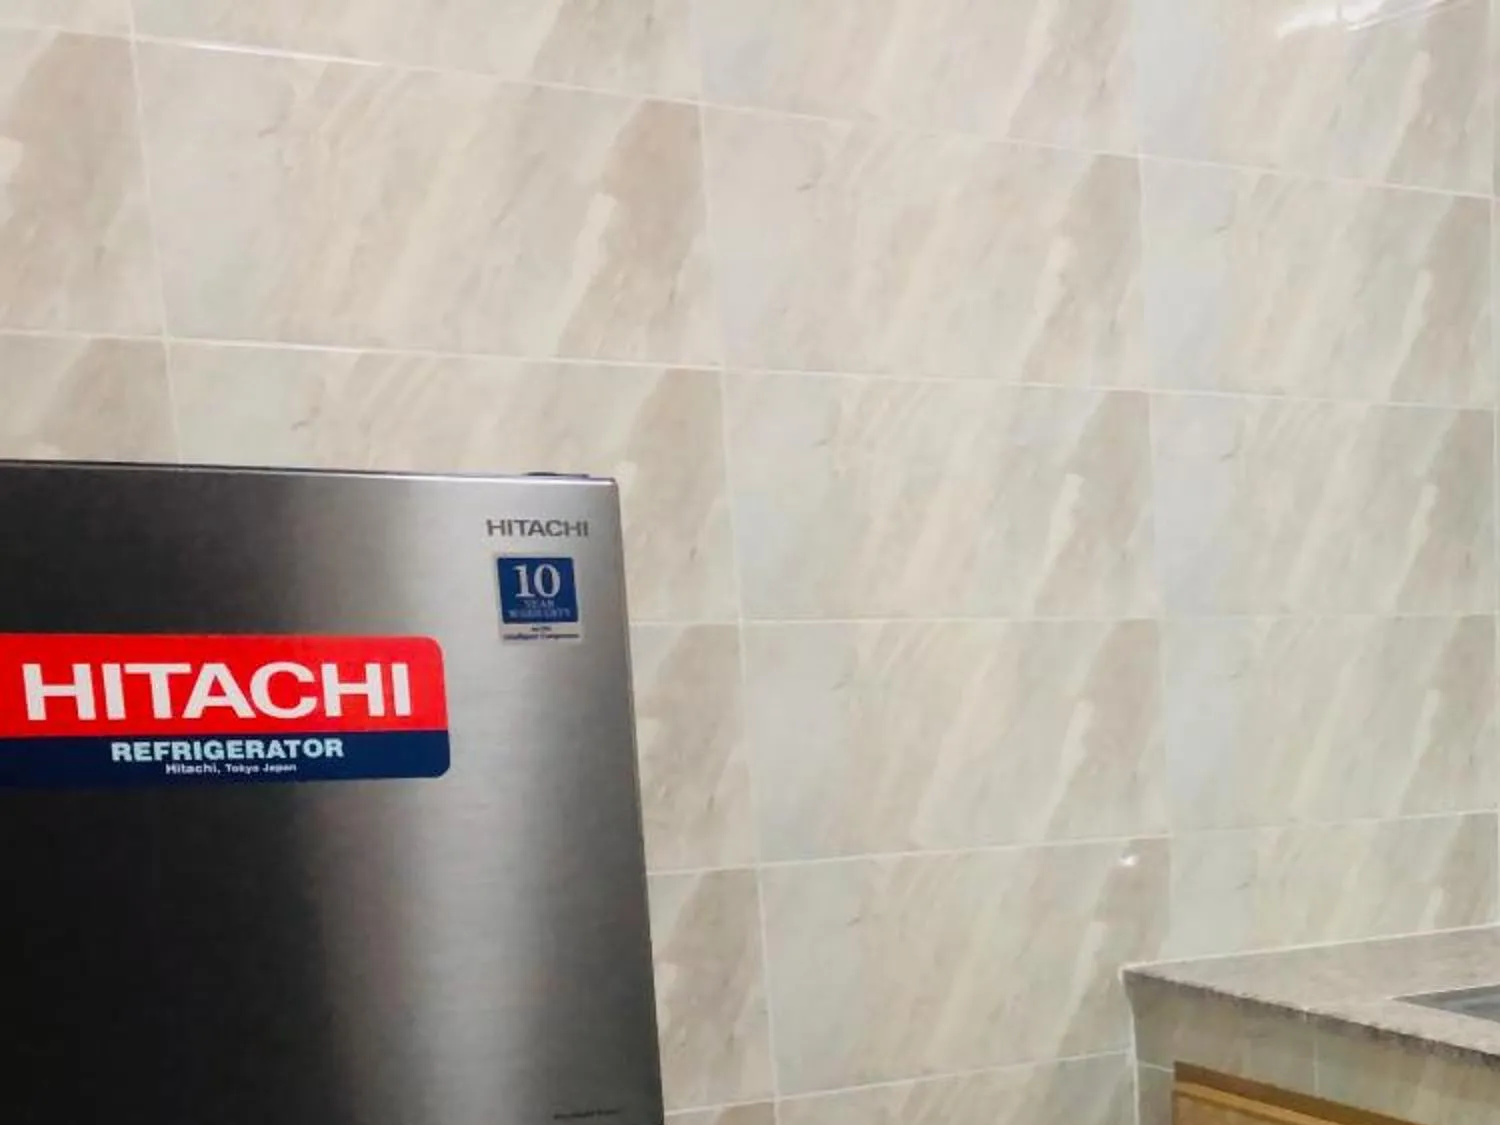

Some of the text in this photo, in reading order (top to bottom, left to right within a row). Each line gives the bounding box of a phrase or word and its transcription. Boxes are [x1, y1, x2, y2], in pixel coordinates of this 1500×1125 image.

[486, 518, 589, 537] HITACHI
[512, 562, 561, 598] 10
[22, 661, 412, 721] HITACHI
[111, 737, 344, 762] REFRIGERATOR
[165, 763, 297, 774] Hitachi, Tokyo Japan
